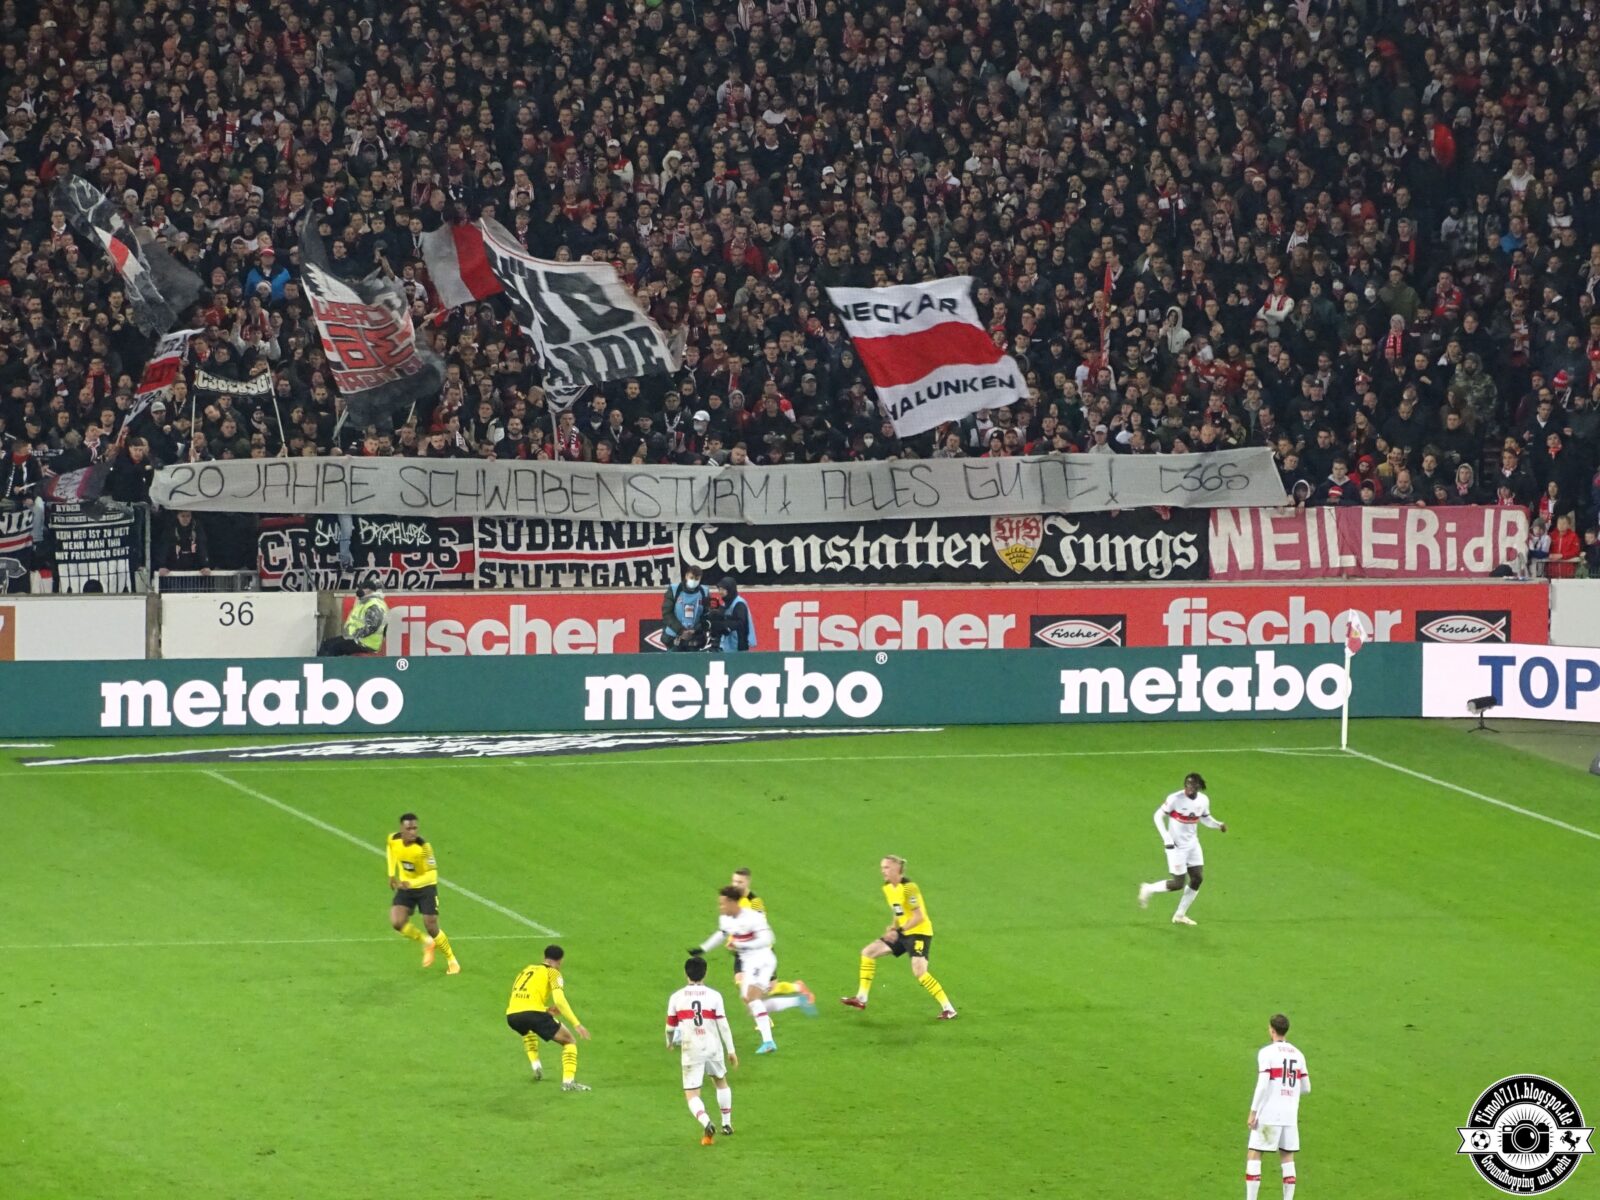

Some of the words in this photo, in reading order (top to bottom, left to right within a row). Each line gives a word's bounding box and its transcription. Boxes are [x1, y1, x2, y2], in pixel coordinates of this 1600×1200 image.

[838, 294, 959, 324] NECKAR
[169, 466, 225, 501] 20
[231, 462, 379, 506] JAHRE
[399, 466, 792, 518] SCHWABENSTURM!
[821, 464, 940, 511] ALLES
[963, 457, 1119, 505] GUTE!
[62, 541, 85, 550] WENN
[87, 539, 105, 549] MAN
[89, 529, 100, 539] IST
[103, 528, 112, 538] ZU
[478, 516, 674, 552] SÜDBANDE
[680, 521, 990, 576] Cannstatter
[1036, 515, 1199, 580] Jungs
[55, 551, 69, 560] MIT
[70, 549, 111, 560] FREUNDEN
[479, 557, 675, 589] STUTTGART
[218, 601, 254, 626] 36
[386, 605, 625, 656] fischer
[773, 600, 1016, 651] fischer
[1163, 596, 1402, 646] fischer
[1435, 623, 1486, 634] fischer
[1050, 628, 1101, 639] fischer
[101, 663, 404, 727] metabo
[585, 657, 884, 721] metabo
[1060, 650, 1352, 714] metabo
[1478, 655, 1600, 710] TOP
[691, 1000, 703, 1027] 3
[1282, 1058, 1298, 1088] 15
